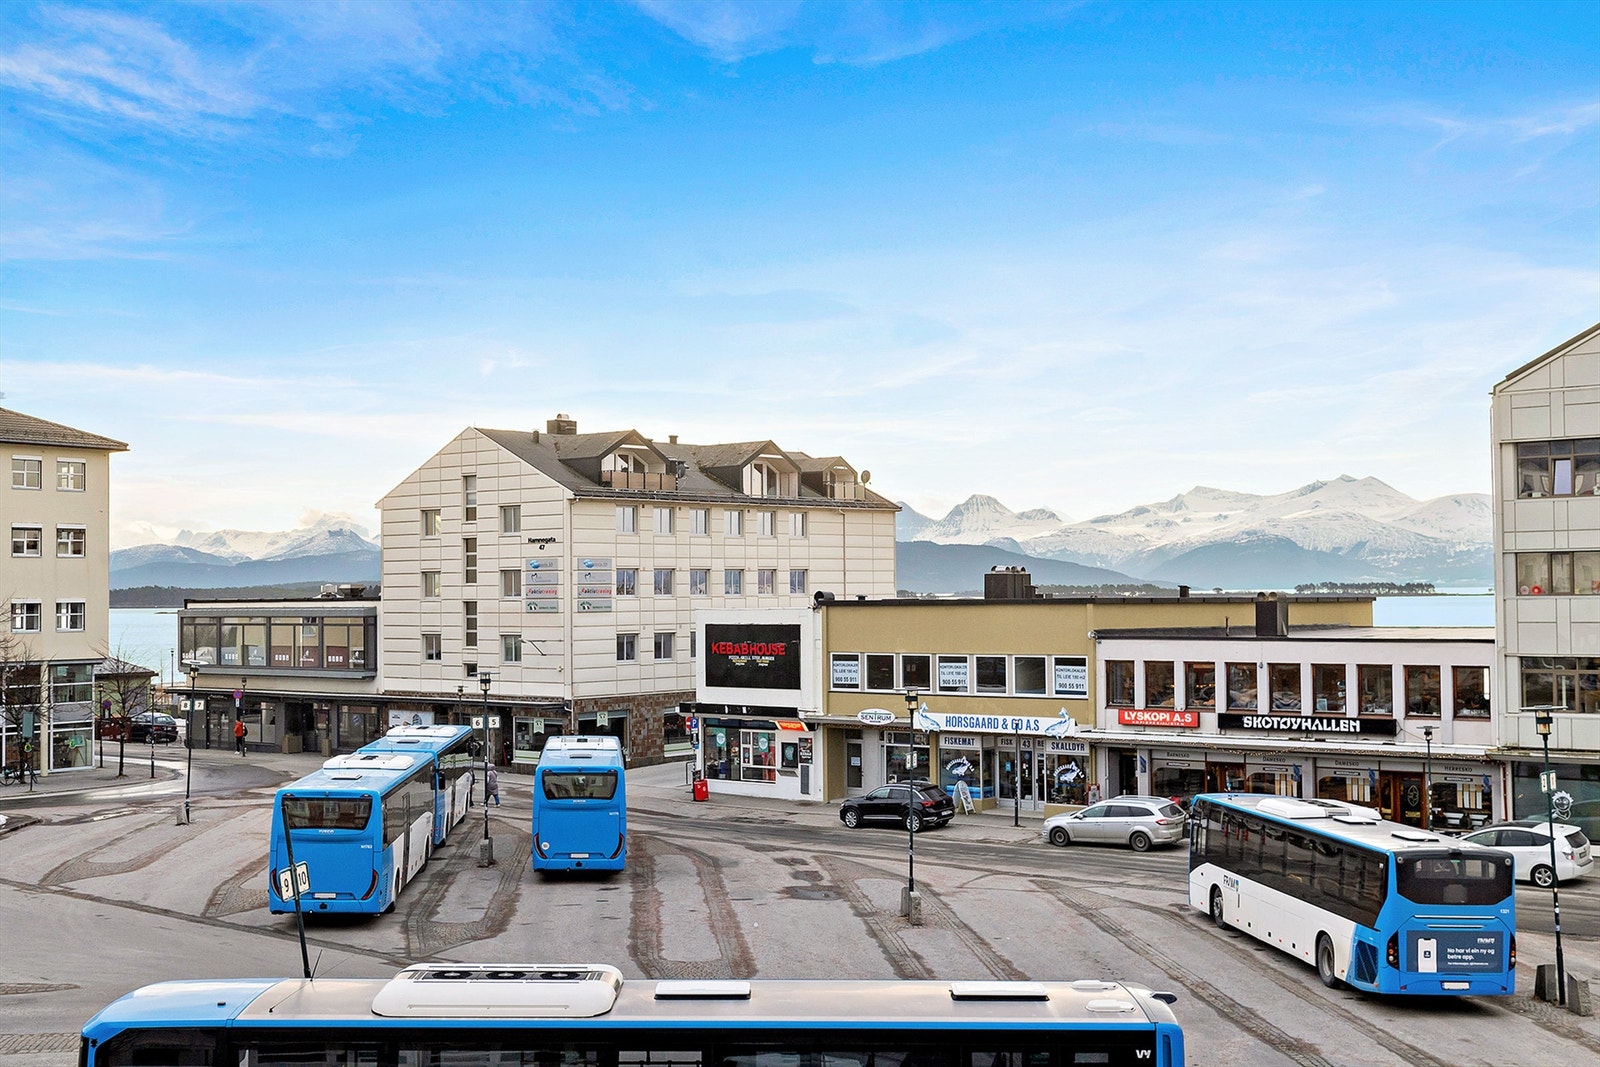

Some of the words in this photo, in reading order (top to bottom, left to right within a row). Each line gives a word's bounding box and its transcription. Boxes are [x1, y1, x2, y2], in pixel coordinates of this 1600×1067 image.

[860, 712, 892, 721] SENTRUM
[1124, 711, 1170, 721] LYSKOPI
[1173, 713, 1192, 723] A.S
[945, 716, 998, 729] HORSGAARD
[1001, 718, 1008, 730] &
[1025, 719, 1040, 731] A.S
[1243, 716, 1361, 732] SKOTØYHALLEN
[944, 737, 975, 746] FISKEMAT
[1001, 738, 1013, 746] FISK
[1022, 740, 1031, 748] 43
[1051, 741, 1085, 751] SKALLDYR
[298, 871, 307, 886] 10
[284, 878, 289, 892] 9
